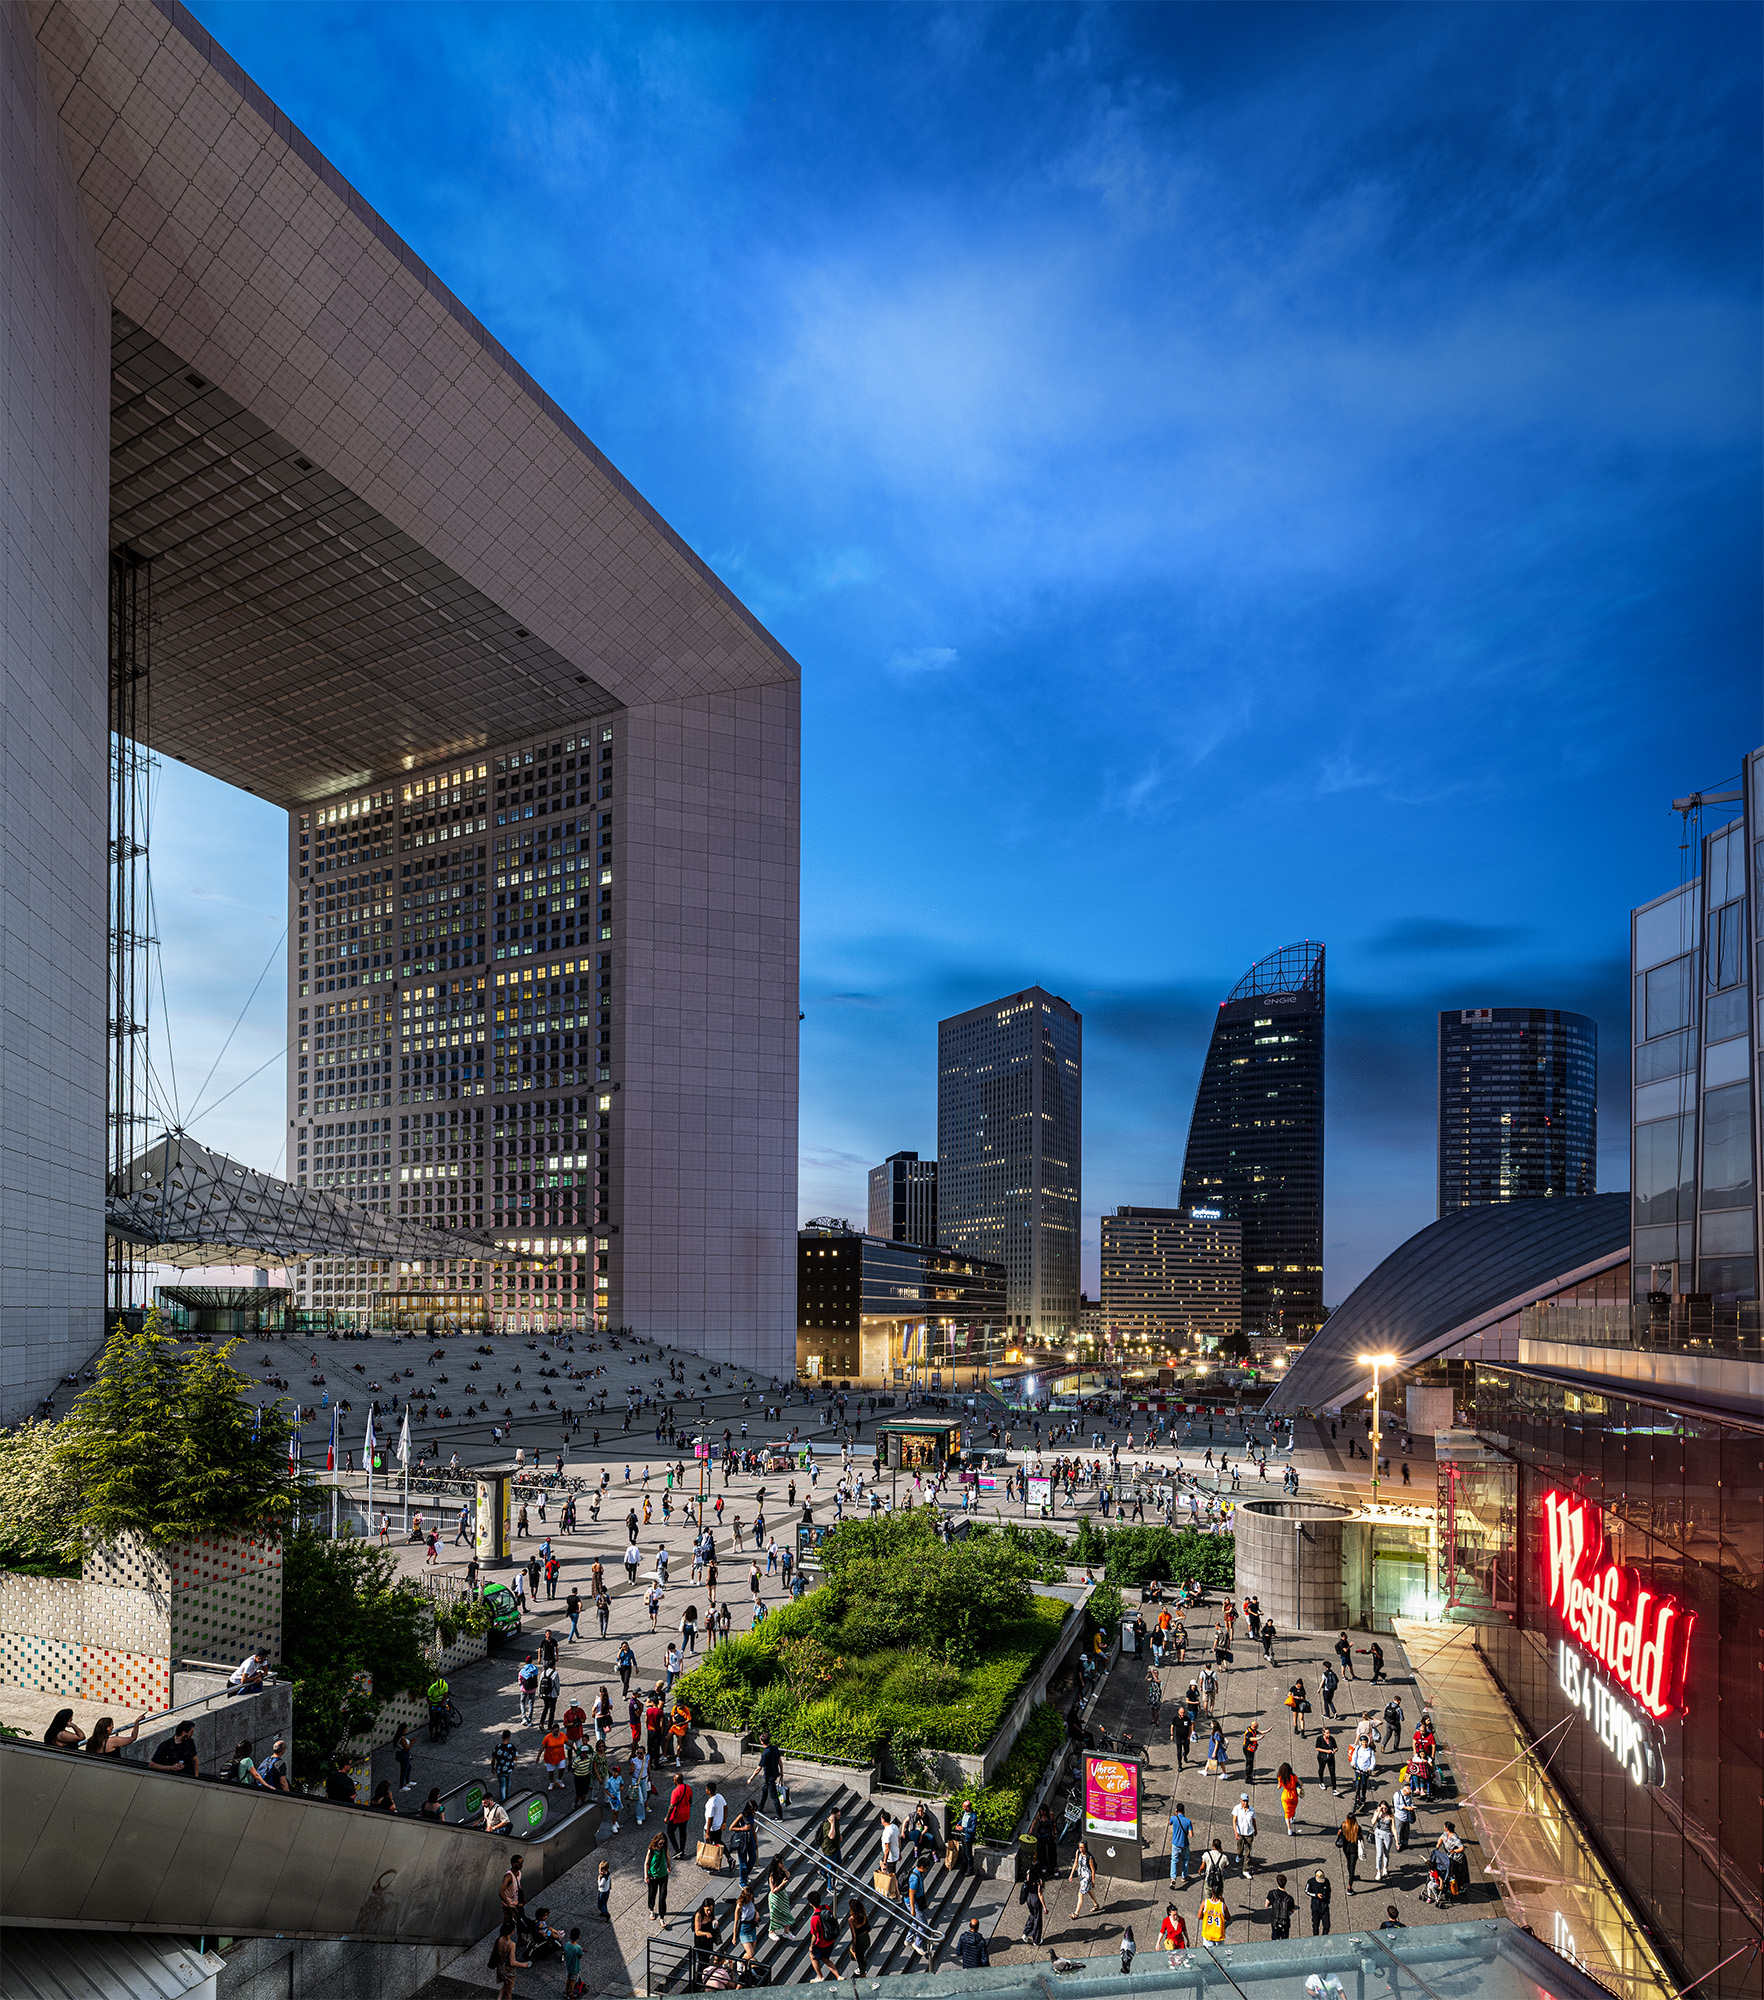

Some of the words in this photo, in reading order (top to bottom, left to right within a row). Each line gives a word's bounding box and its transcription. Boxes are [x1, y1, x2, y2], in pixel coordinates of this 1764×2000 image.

[1545, 1490, 1674, 1717] Westfield
[1559, 1639, 1581, 1707] LES
[1582, 1667, 1592, 1722] 4
[1593, 1676, 1644, 1786] TEMPS
[1091, 1761, 1117, 1777] Vibrez
[1106, 1779, 1115, 1790] de
[1207, 1915, 1221, 1927] 34
